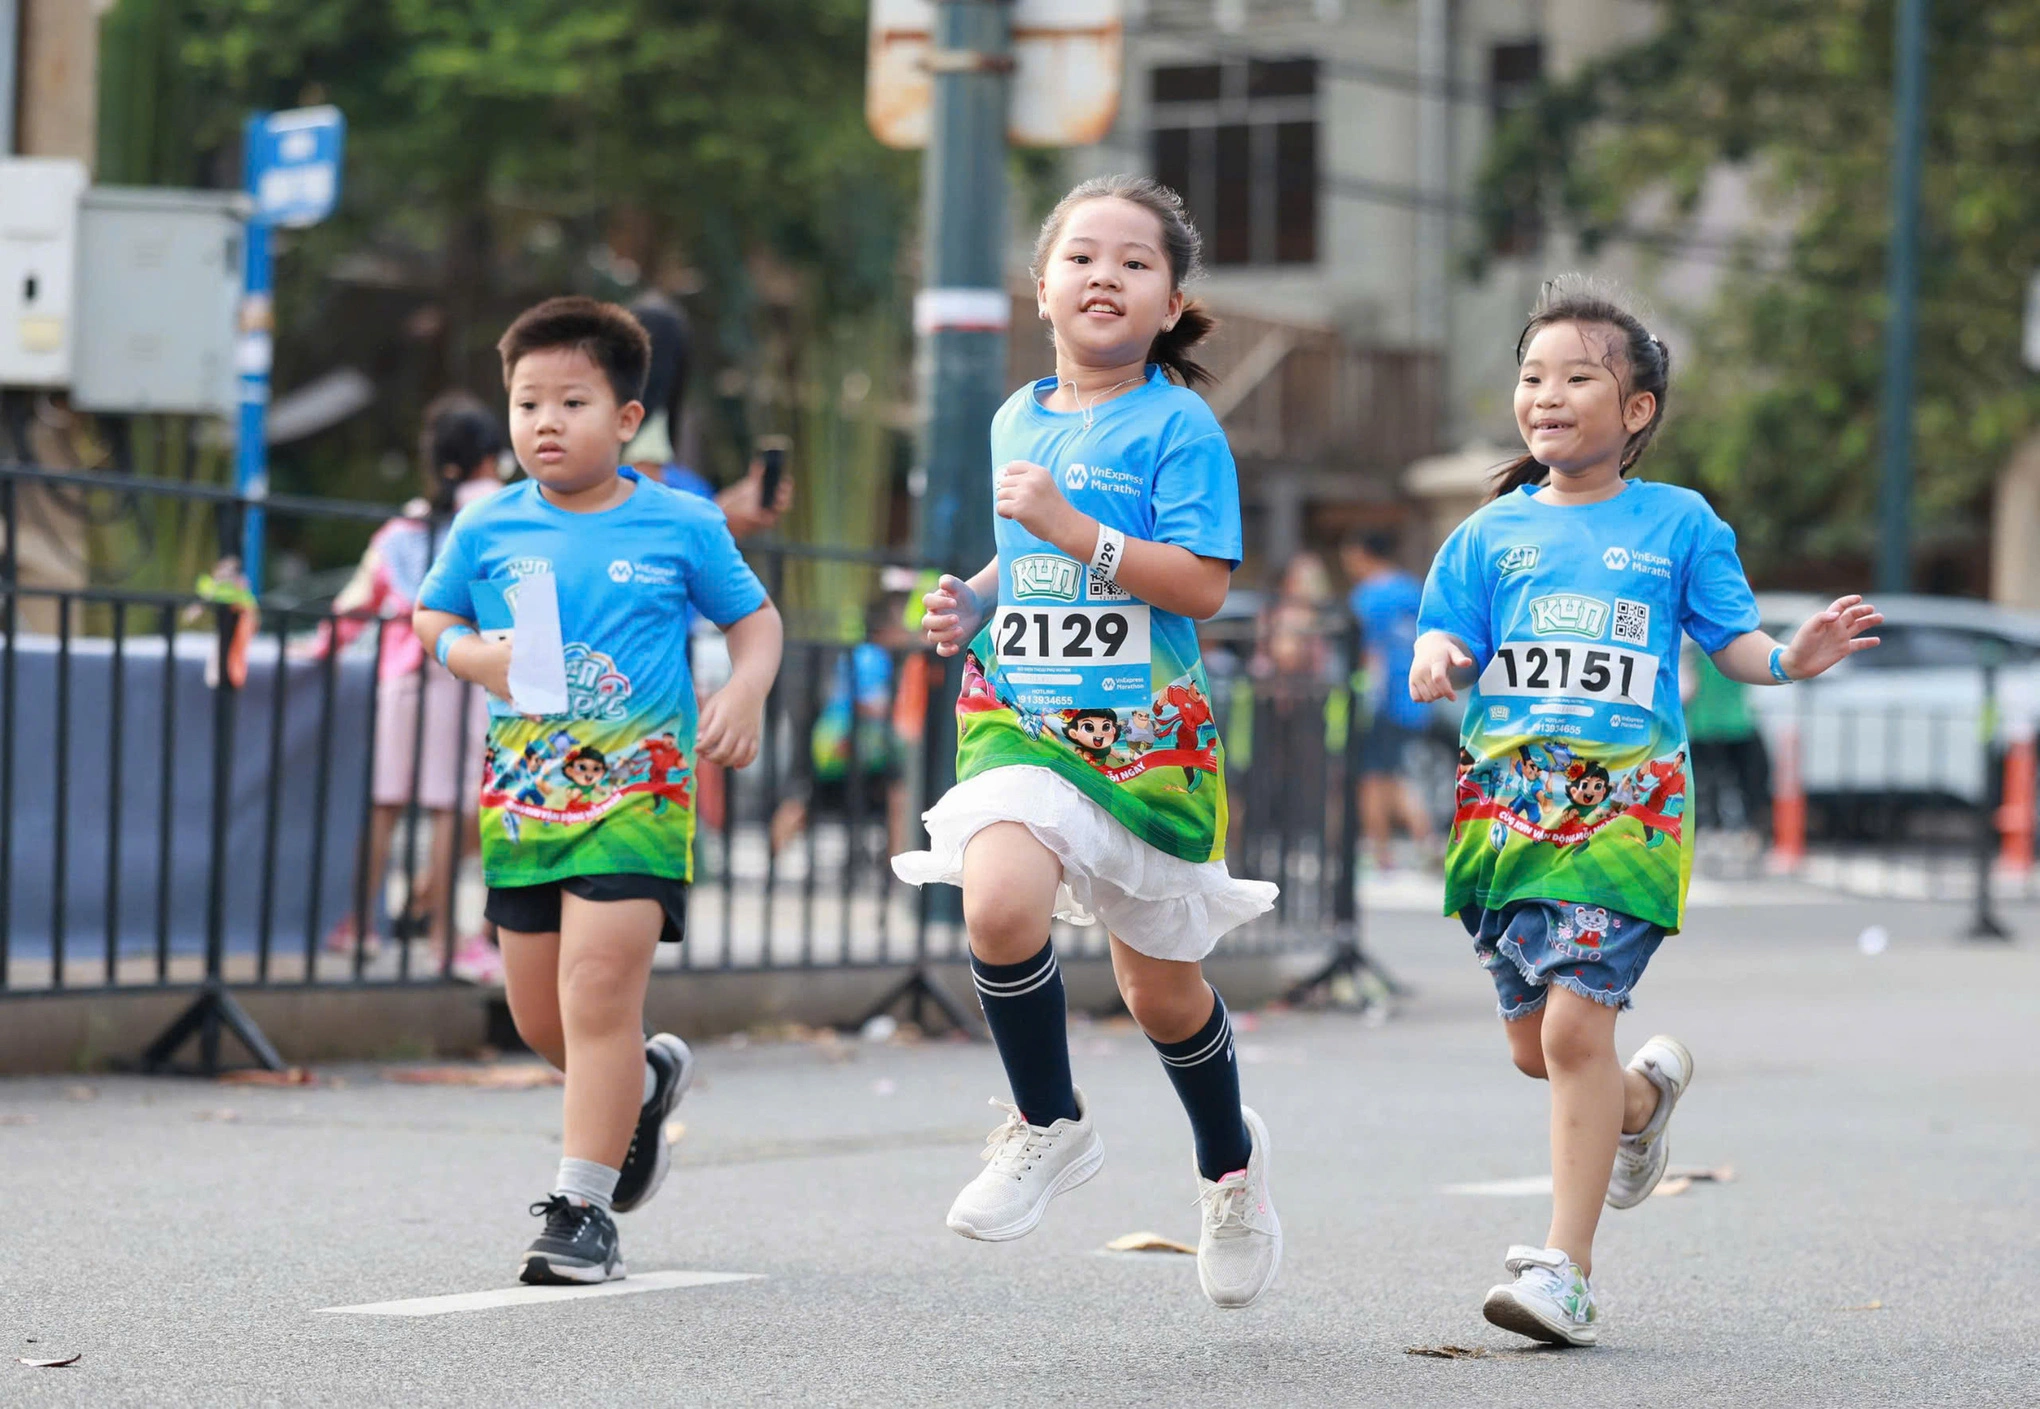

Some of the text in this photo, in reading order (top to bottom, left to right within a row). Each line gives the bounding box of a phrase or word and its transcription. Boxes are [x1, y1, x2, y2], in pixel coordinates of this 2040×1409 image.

[1090, 465, 1144, 485] VnExpress
[996, 612, 1129, 657] 2129
[1498, 647, 1634, 697] 12151
[1106, 770, 1120, 782] ỖI
